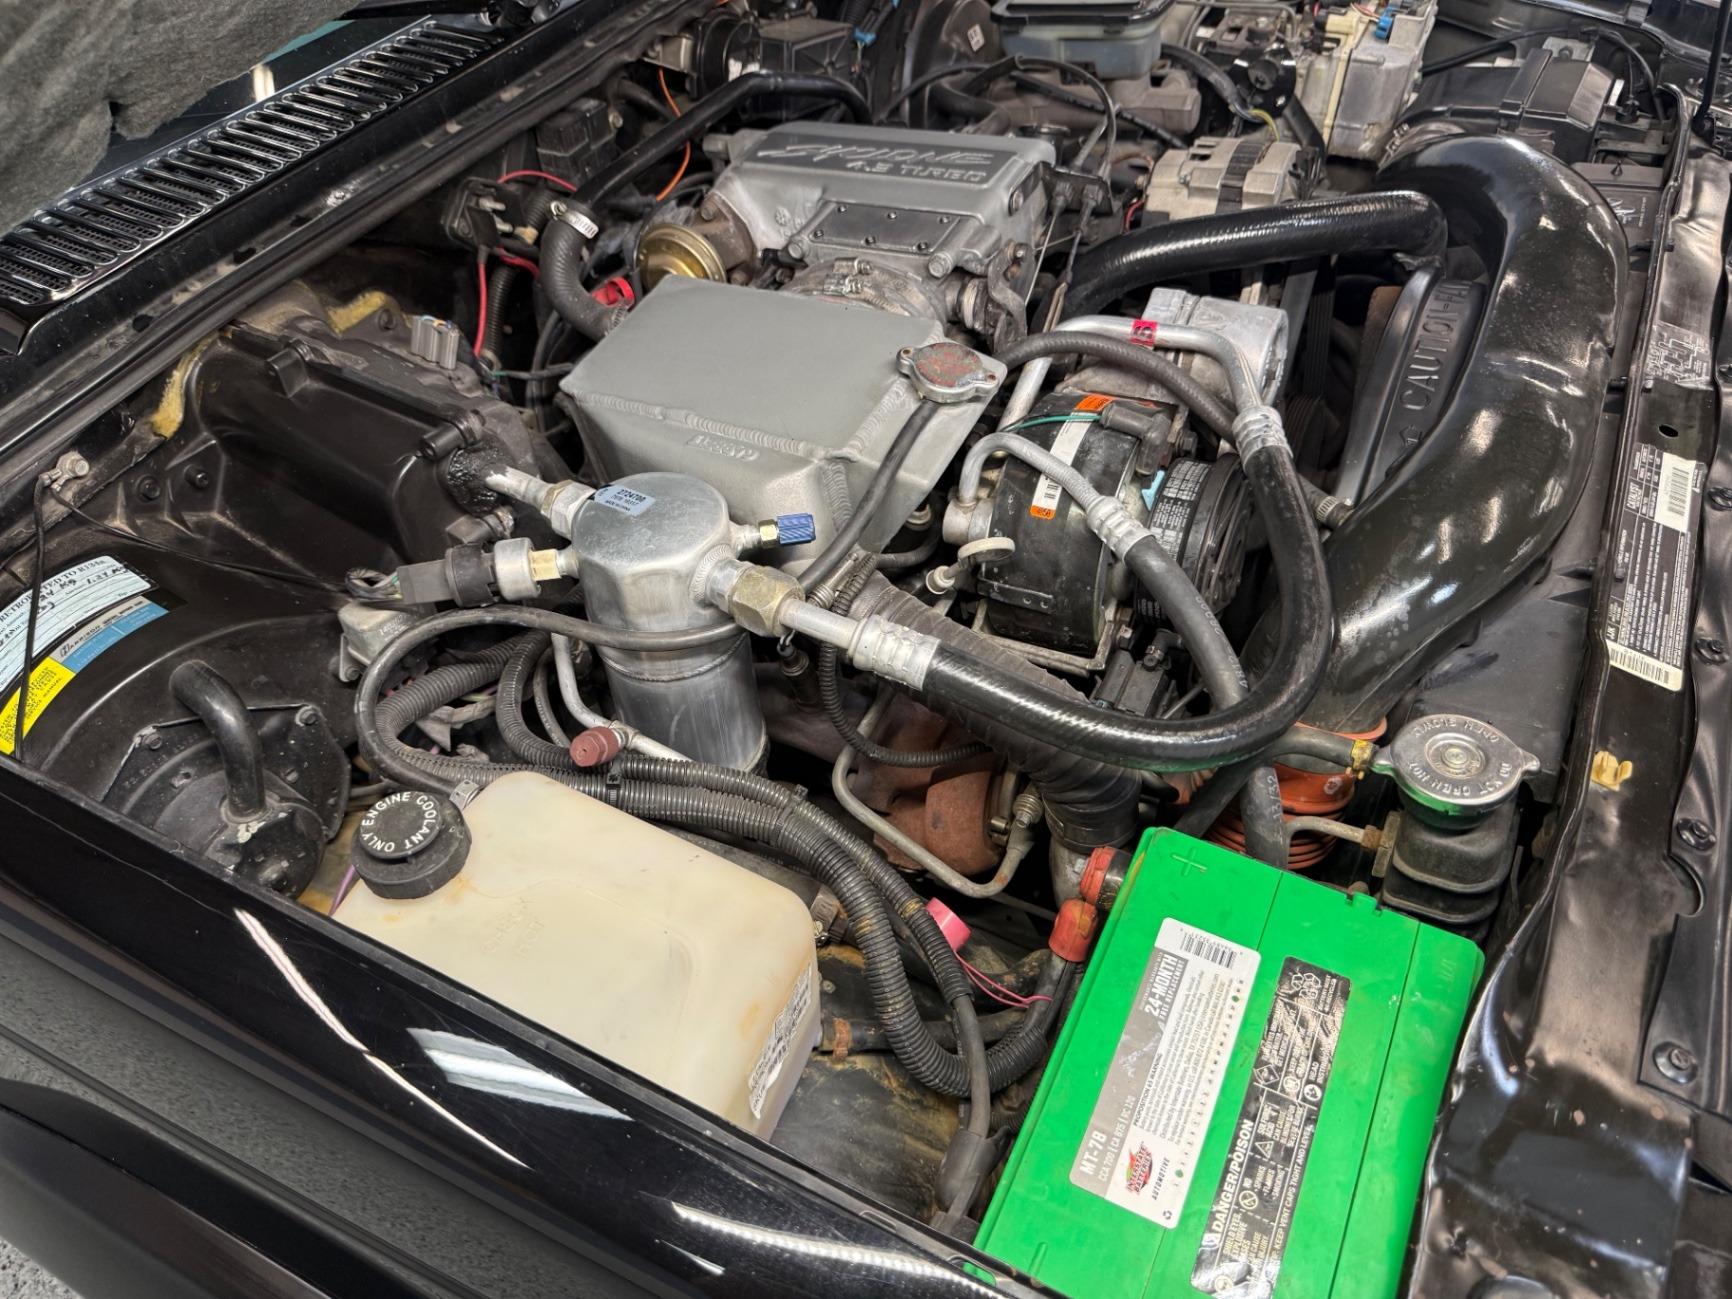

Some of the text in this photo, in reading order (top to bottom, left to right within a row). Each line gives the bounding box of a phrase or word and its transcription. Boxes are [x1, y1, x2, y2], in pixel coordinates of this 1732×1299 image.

[899, 163, 988, 182] TURBO
[63, 570, 77, 581] TO
[1463, 720, 1500, 743] OPEN
[1408, 762, 1431, 783] HOT
[1431, 778, 1471, 796] OPEN
[1479, 779, 1503, 796] NOT
[362, 791, 437, 853] ENGINE COOLANT ONLY
[1143, 952, 1179, 1016] 24-MONTH
[1158, 959, 1185, 1020] FREE REPLACEMENT
[1148, 1052, 1162, 1079] WARNING
[1307, 1060, 1320, 1081] READ
[1078, 1129, 1107, 1175] MT-78
[1123, 1144, 1147, 1192] INTERSTATE
[1132, 1150, 1152, 1192] BATTERIES
[1149, 1157, 1171, 1200] AUTOMOTIVE
[1211, 1118, 1254, 1232] DANGER/POISON
[1288, 1163, 1302, 1186] TIGHT
[1242, 1176, 1253, 1188] NO
[1283, 1185, 1295, 1207] CAPS
[1278, 1206, 1290, 1227] VENT
[1272, 1227, 1285, 1249] KEEP
